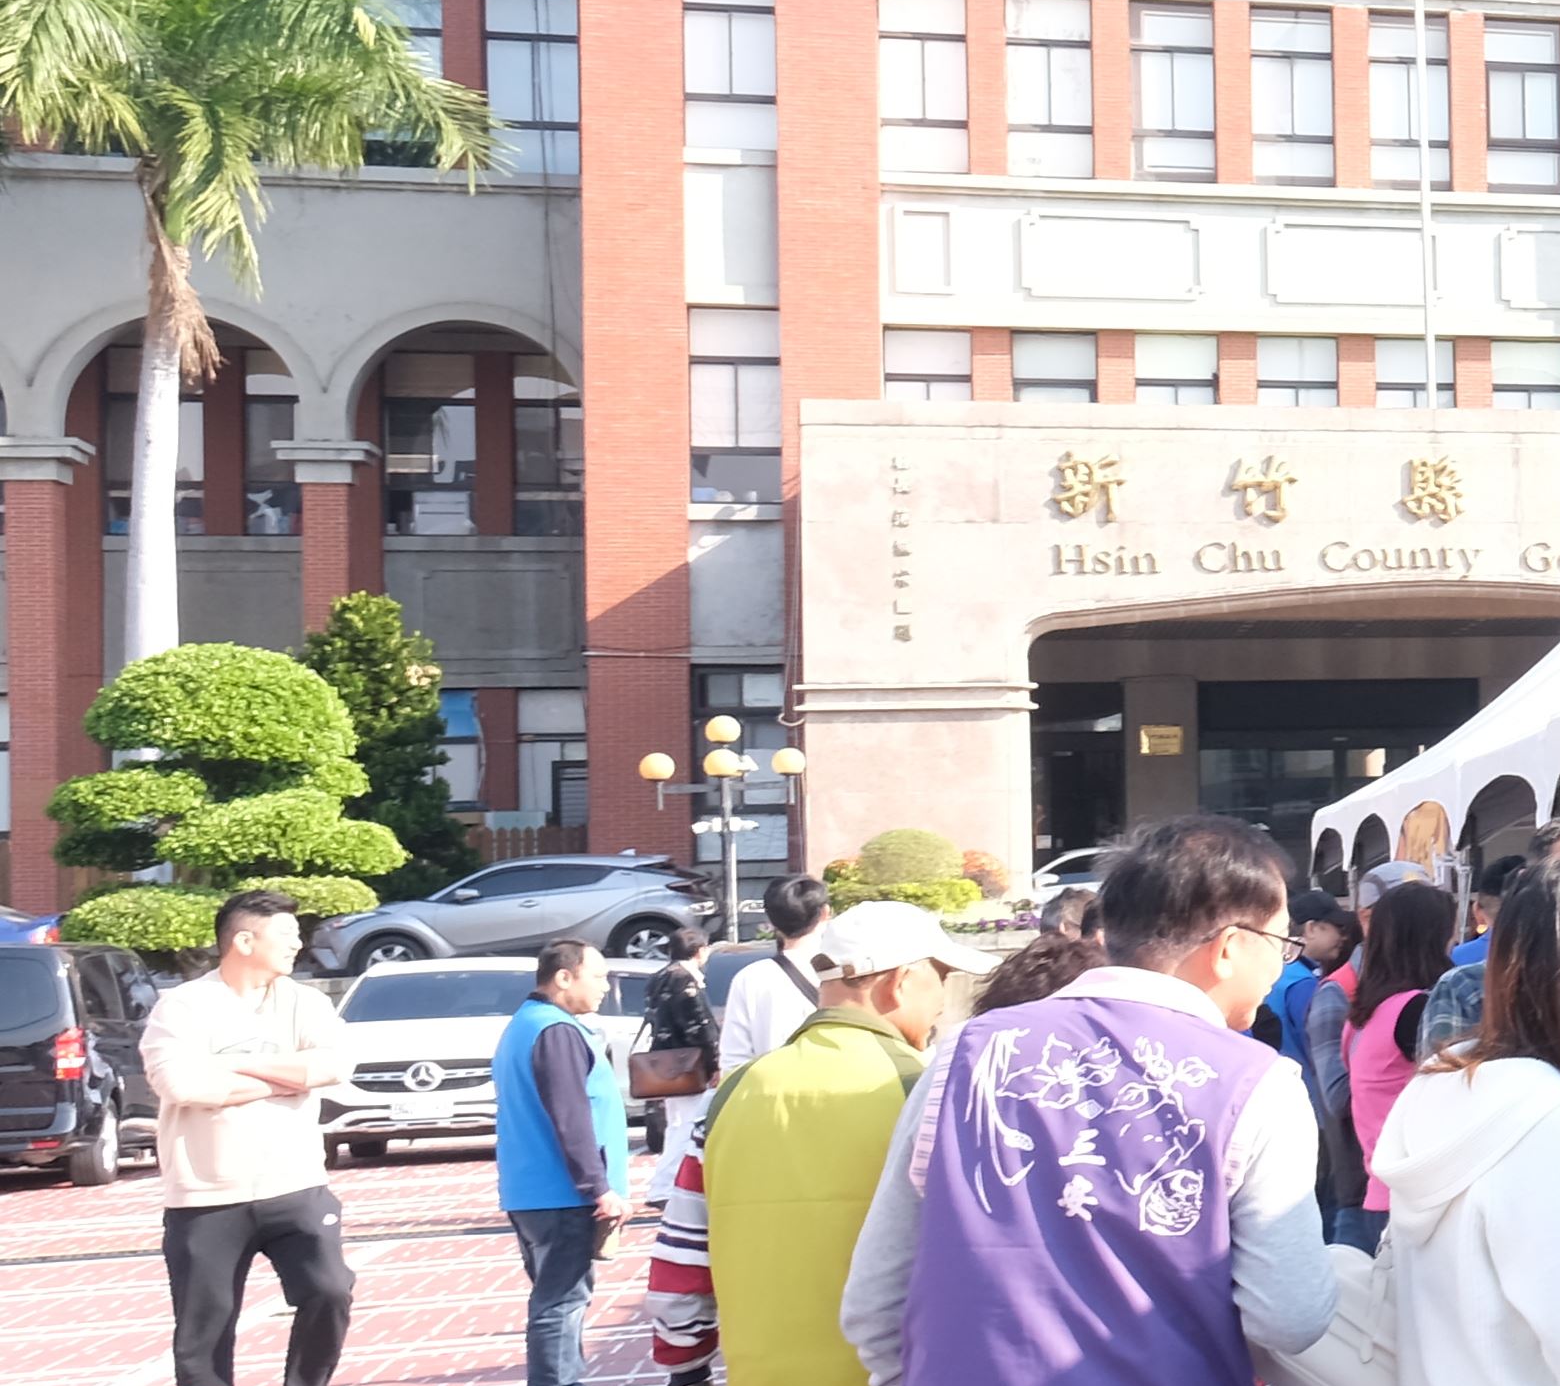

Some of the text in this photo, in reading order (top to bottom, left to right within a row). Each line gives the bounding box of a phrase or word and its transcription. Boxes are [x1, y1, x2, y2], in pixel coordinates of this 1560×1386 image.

[1050, 541, 1161, 577] Hsin
[1192, 540, 1286, 575] Chu
[1317, 540, 1481, 581] County
